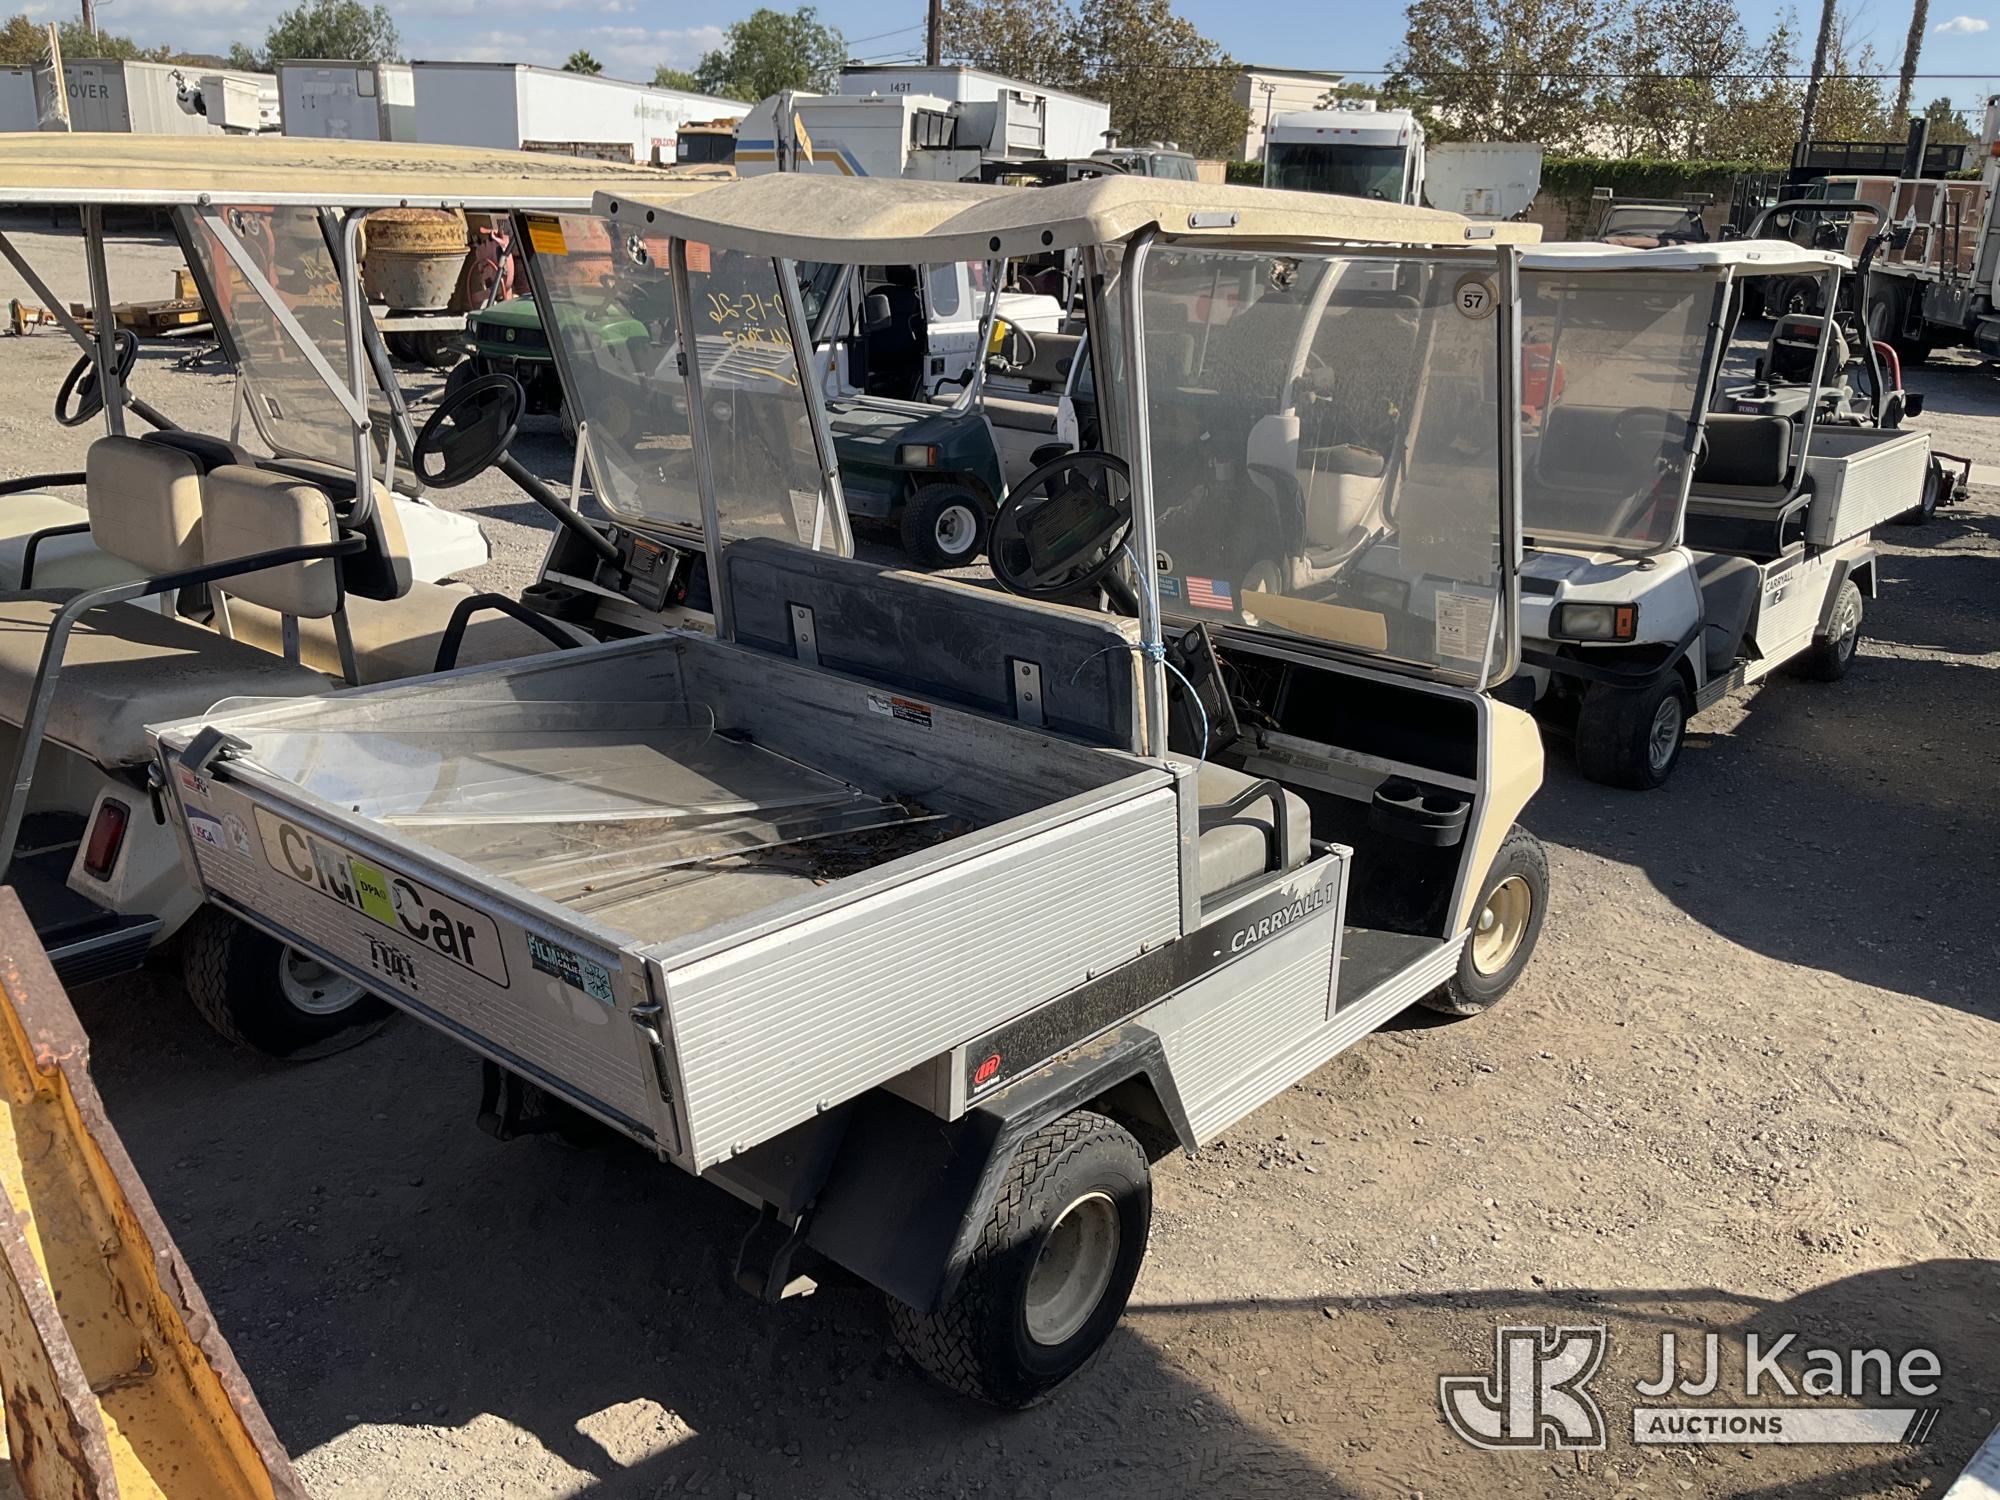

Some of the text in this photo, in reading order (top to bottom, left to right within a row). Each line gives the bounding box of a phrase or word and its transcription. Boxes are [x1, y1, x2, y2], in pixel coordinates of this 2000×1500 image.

[1464, 294, 1483, 308] 57
[1765, 570, 1793, 593] CARRYALL
[1774, 590, 1782, 604] 2
[392, 878, 475, 966] Car
[1230, 882, 1334, 953] CARRYALL 1
